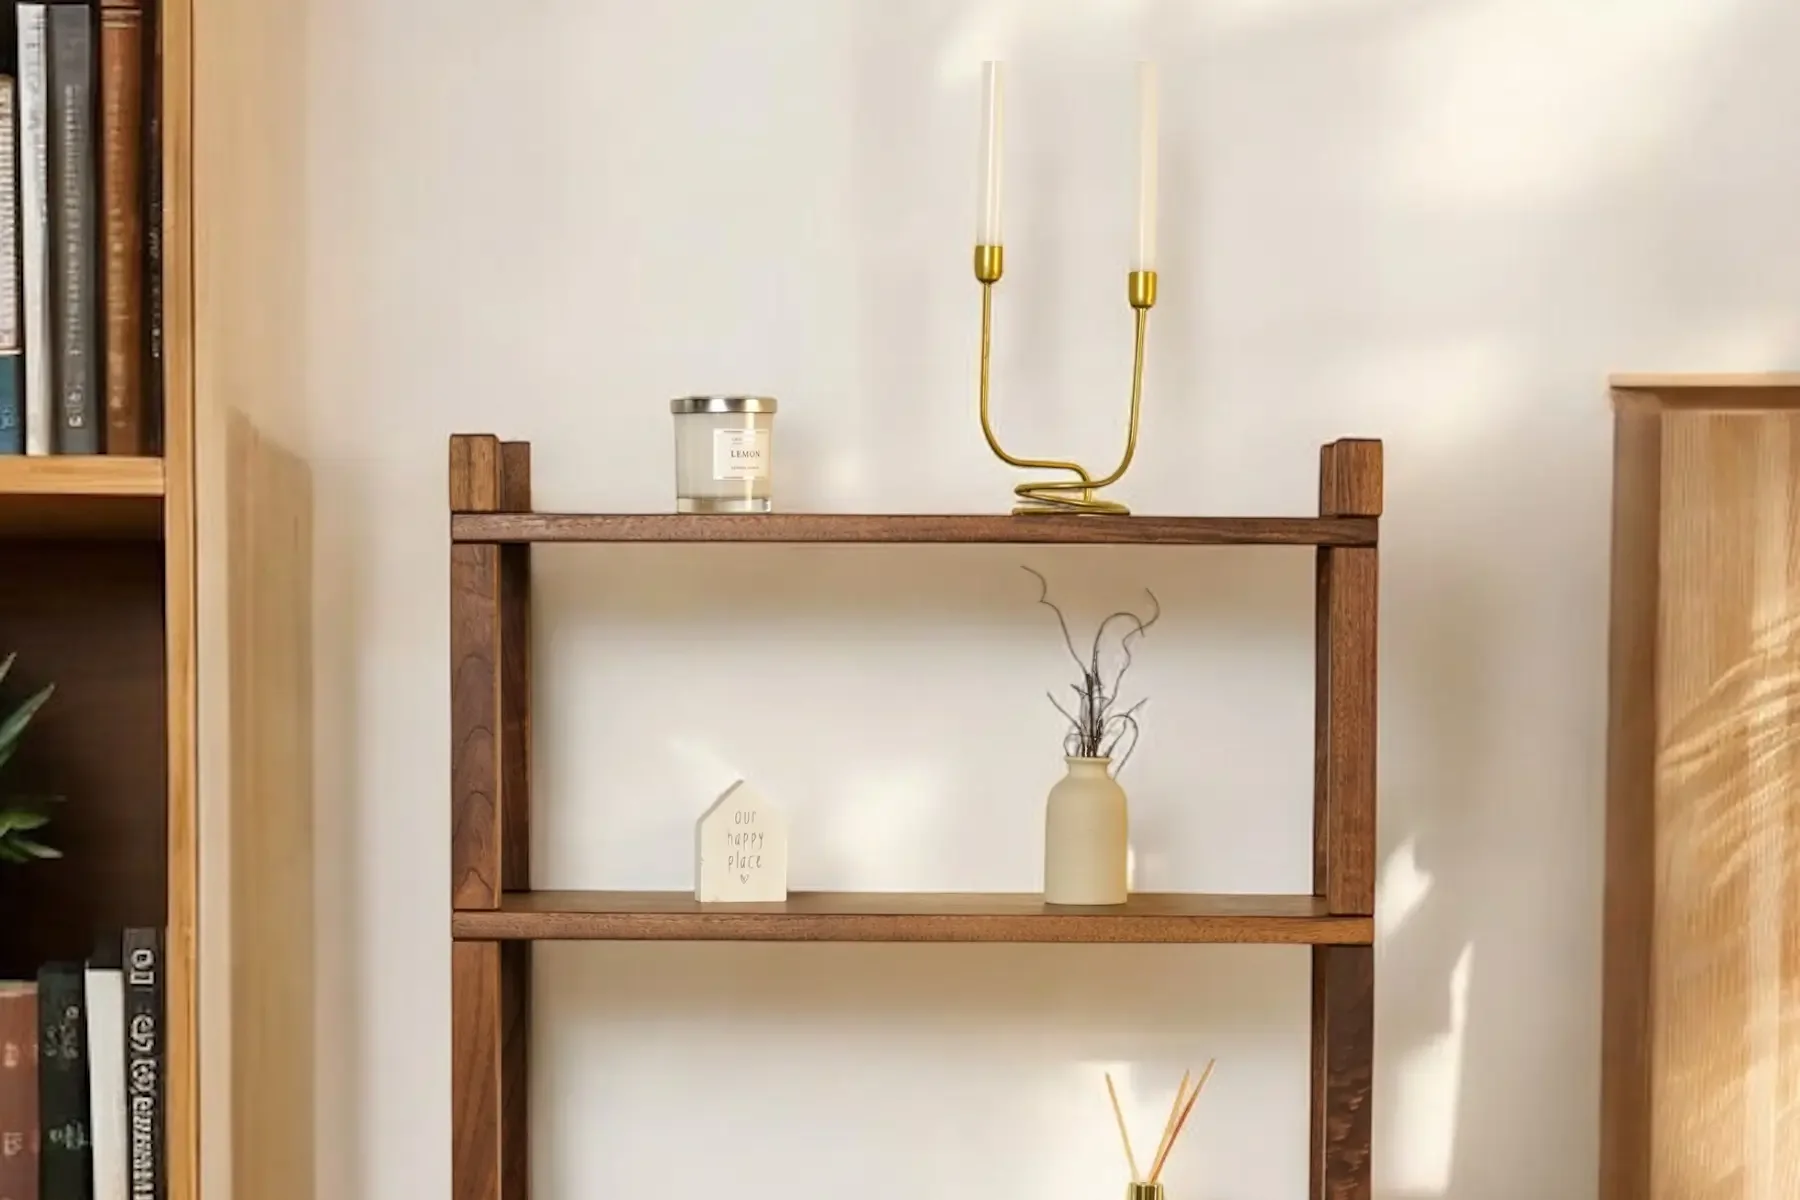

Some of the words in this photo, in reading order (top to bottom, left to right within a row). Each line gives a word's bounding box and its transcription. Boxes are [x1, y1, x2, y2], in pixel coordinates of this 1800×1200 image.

[731, 450, 760, 458] LEMON
[727, 829, 763, 850] happy
[728, 851, 762, 873] place
